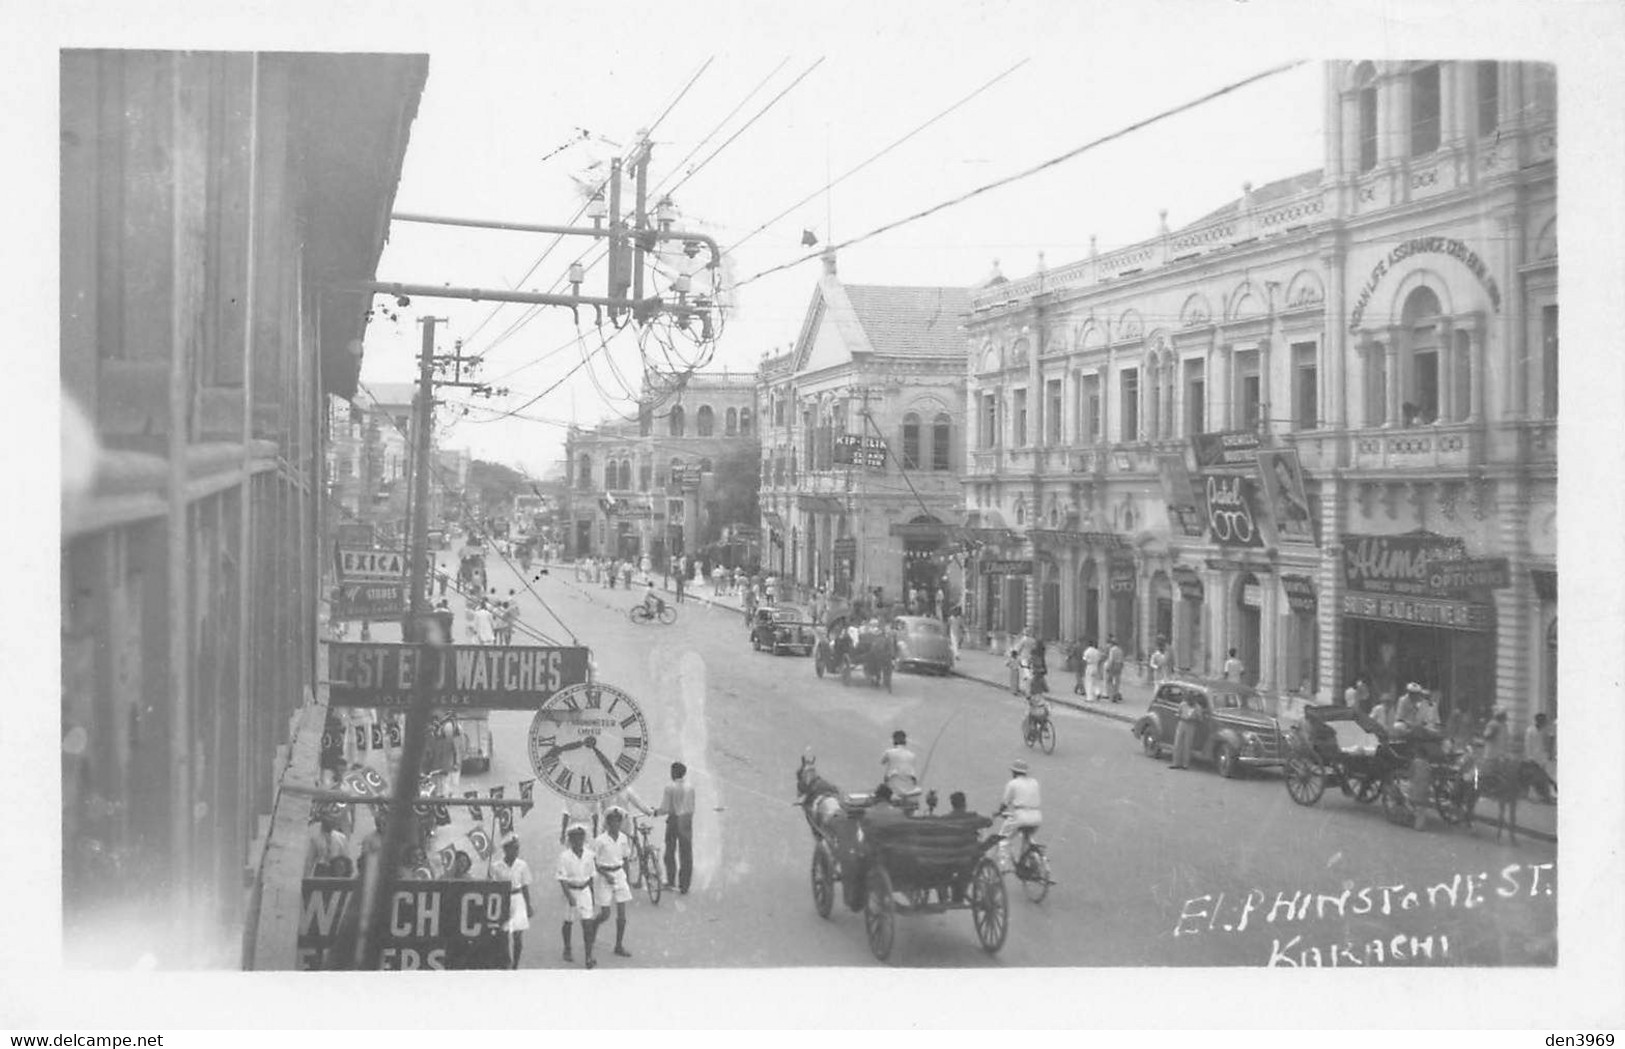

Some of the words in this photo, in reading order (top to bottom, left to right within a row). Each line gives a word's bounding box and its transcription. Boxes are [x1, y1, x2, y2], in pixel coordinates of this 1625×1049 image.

[455, 649, 562, 692] WATCHES
[584, 690, 602, 709] XII
[298, 890, 441, 937] WCH
